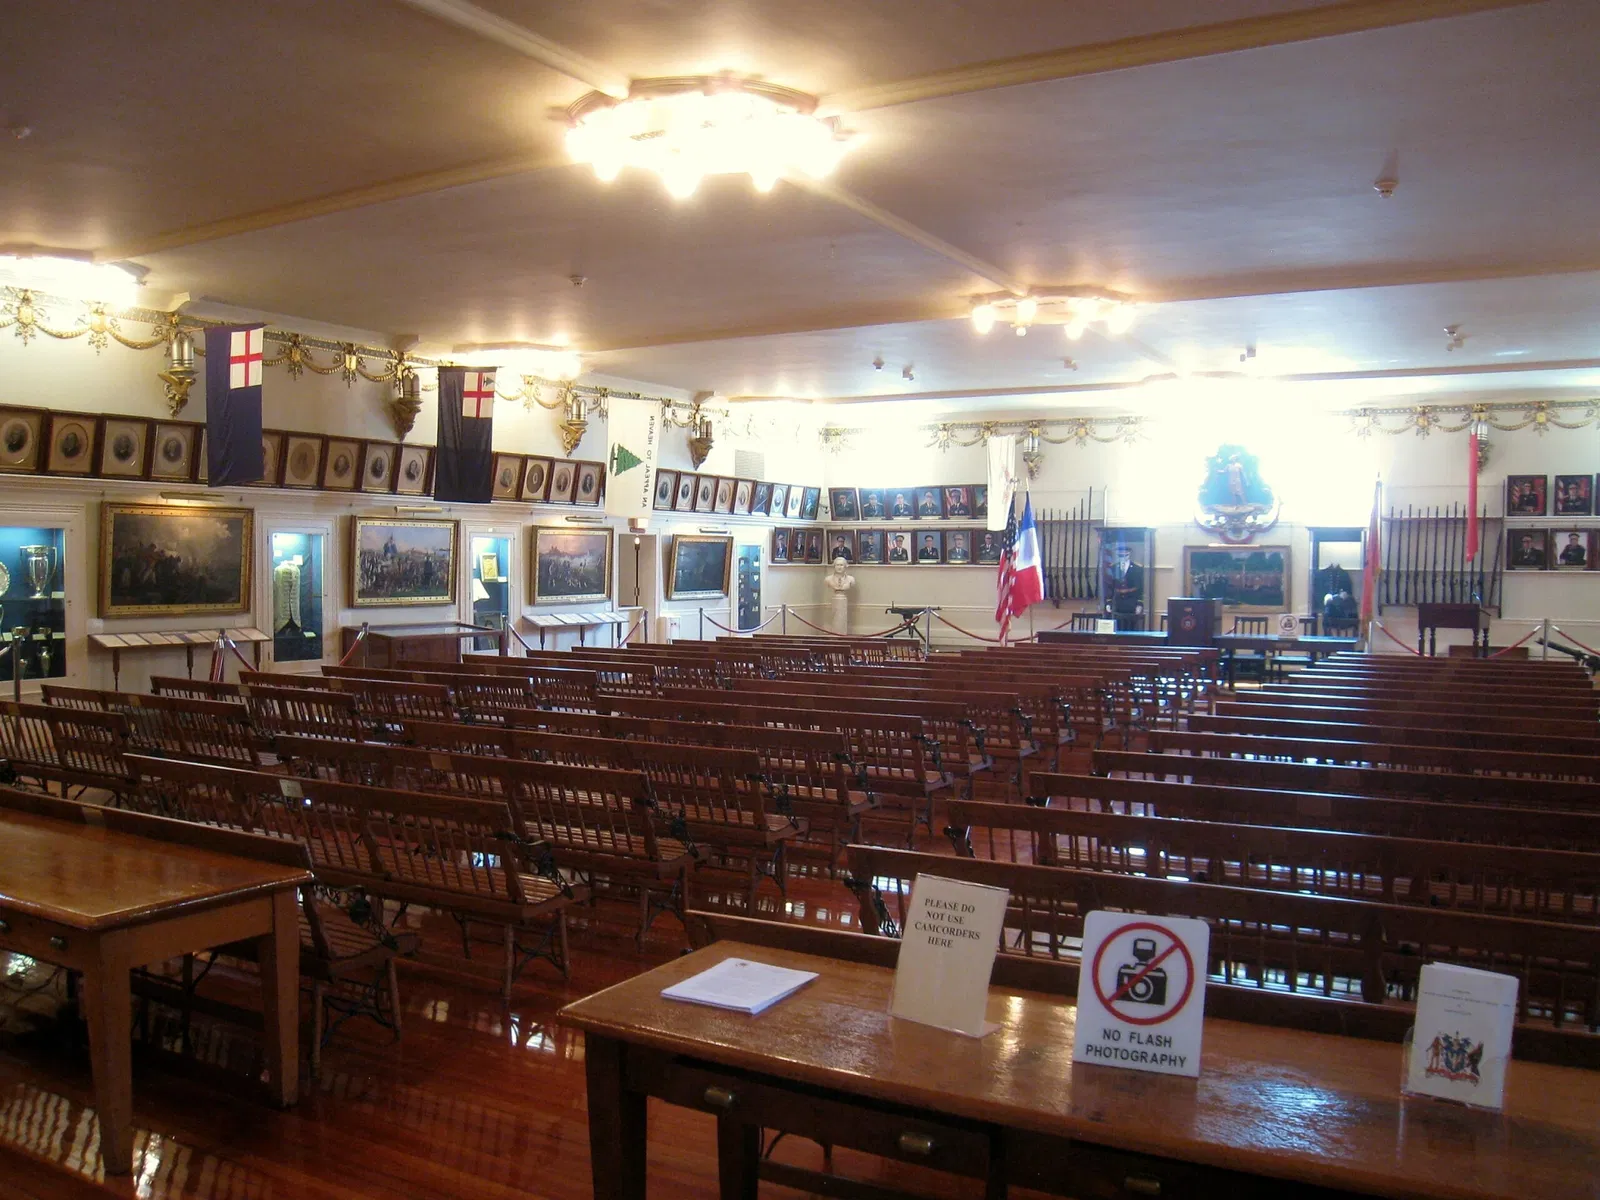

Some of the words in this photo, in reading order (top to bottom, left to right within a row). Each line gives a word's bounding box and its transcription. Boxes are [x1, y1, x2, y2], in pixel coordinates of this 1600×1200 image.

[925, 898, 958, 911] PLEASE
[961, 903, 975, 913] DO
[926, 911, 944, 921] NOT
[948, 914, 965, 925] USE
[914, 921, 981, 940] CAMCORDERS
[928, 936, 953, 948] HERE
[1102, 1028, 1121, 1041] NO
[1129, 1032, 1173, 1048] FLASH
[1085, 1044, 1187, 1068] PHOTOGRAPHY
